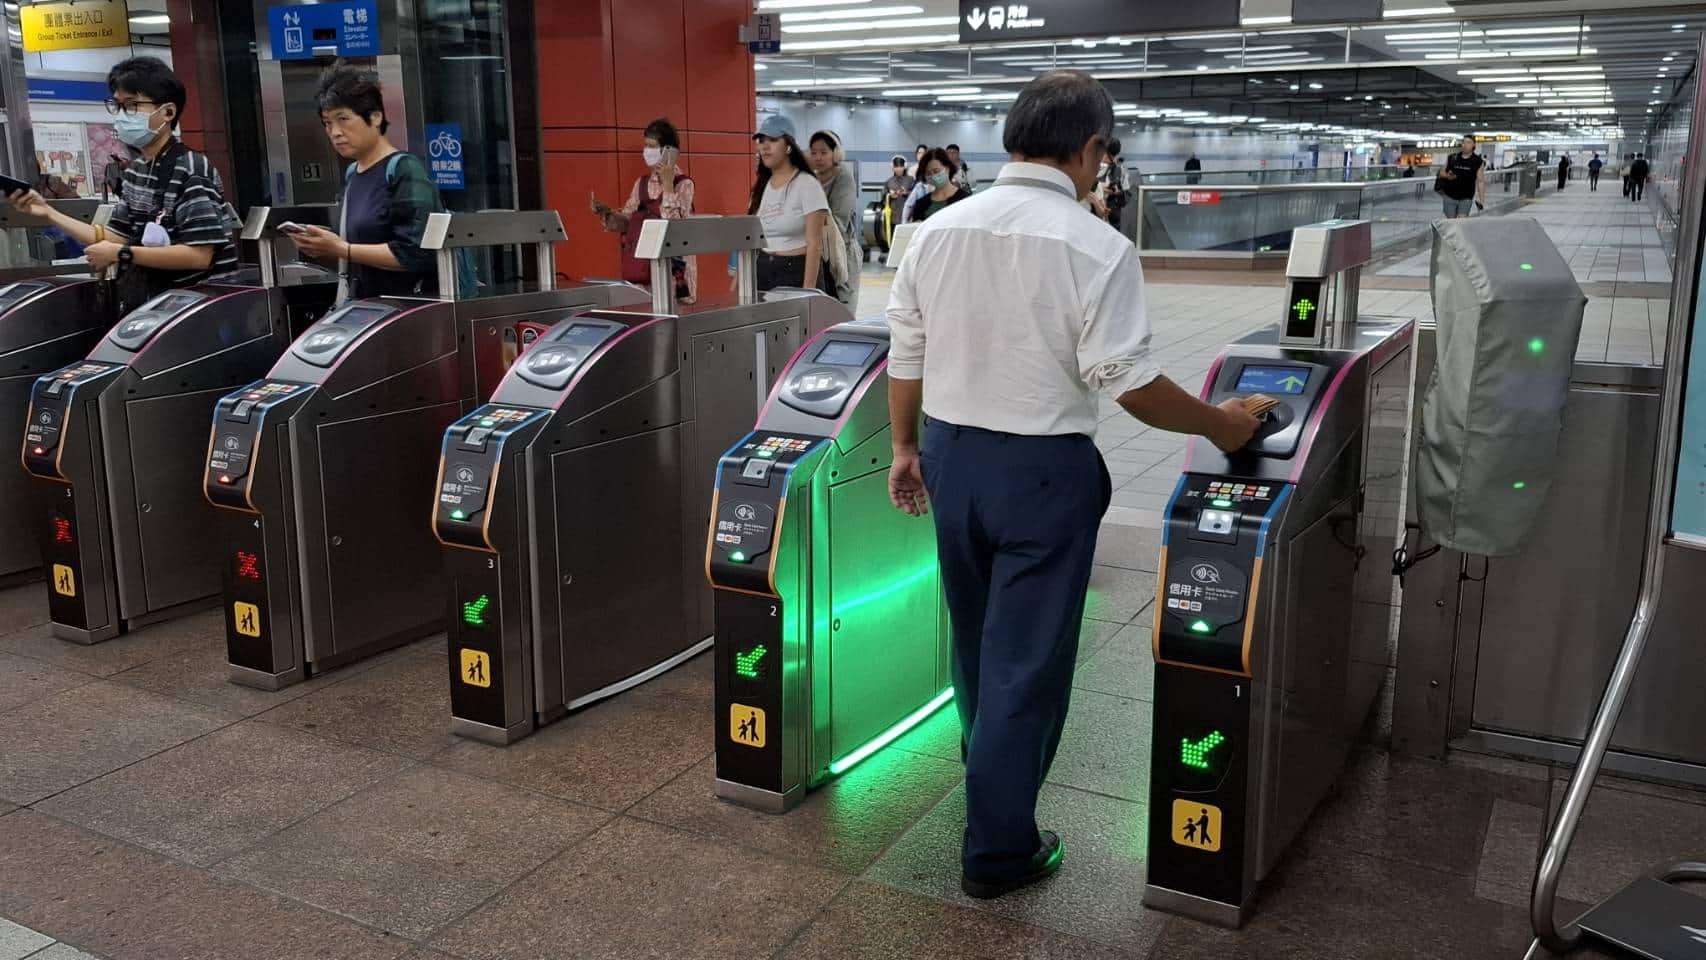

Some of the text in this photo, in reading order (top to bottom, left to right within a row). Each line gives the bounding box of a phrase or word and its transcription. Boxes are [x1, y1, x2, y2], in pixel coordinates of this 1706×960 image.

[343, 8, 368, 24] 電梯
[66, 488, 71, 497] 5
[253, 519, 259, 529] 4
[718, 520, 742, 532] 信用卡
[487, 558, 494, 569] 3
[1169, 582, 1202, 598] 信用卡
[770, 605, 777, 617] 2
[1234, 685, 1241, 698] 1
